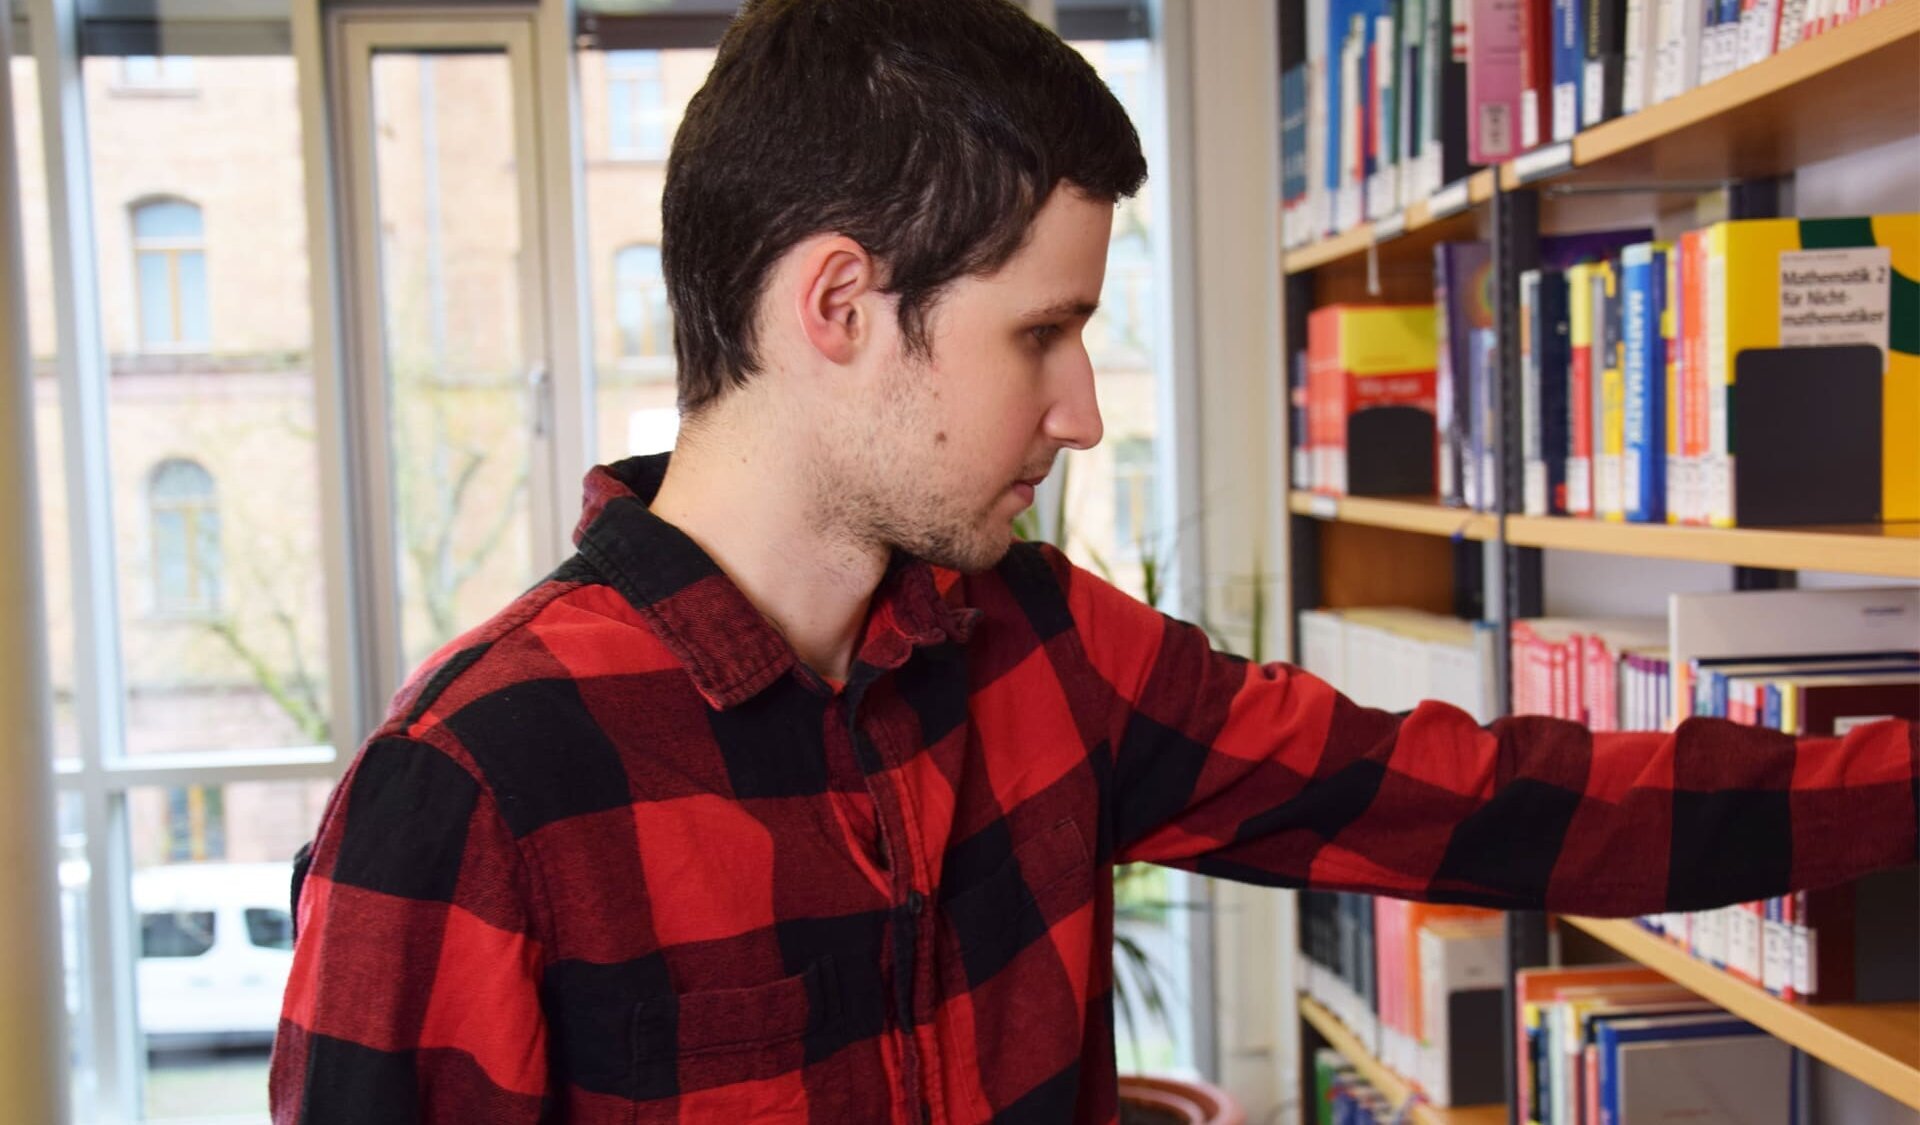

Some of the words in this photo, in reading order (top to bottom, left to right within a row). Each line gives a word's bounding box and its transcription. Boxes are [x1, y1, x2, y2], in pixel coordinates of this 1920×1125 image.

[1782, 268, 1869, 284] Mathematik
[1877, 266, 1885, 284] 2
[1782, 291, 1801, 306] für
[1782, 309, 1884, 326] mathematiker
